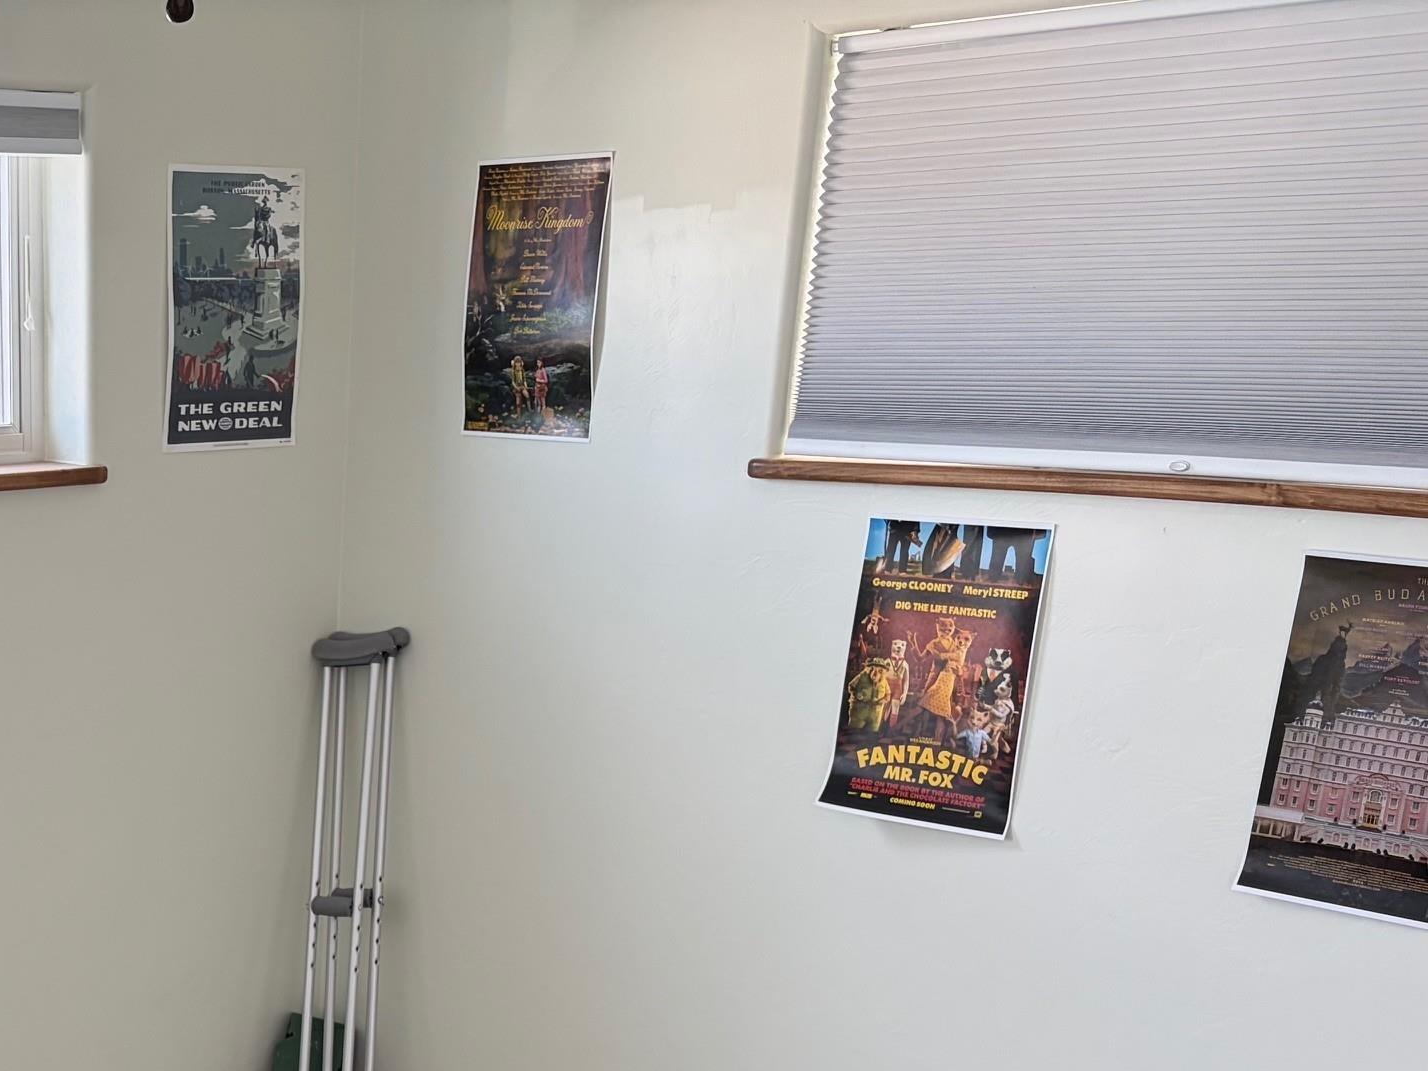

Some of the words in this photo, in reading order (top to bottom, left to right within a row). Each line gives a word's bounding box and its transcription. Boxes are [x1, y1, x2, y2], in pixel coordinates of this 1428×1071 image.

[486, 205, 534, 231] Moonrise
[534, 206, 594, 235] Kingdom
[178, 403, 214, 416] THE
[220, 400, 283, 414] GREEN
[178, 419, 218, 432] NEW
[234, 416, 283, 430] DEAL
[872, 577, 907, 590] George
[908, 581, 954, 594] CLOONEY
[963, 585, 992, 598] Meryl
[992, 588, 1029, 600] STREEP
[895, 601, 911, 610] DIG
[913, 602, 929, 612] THE
[930, 604, 947, 614] LIFE
[948, 606, 997, 619] FANTASTIC
[1309, 594, 1361, 621] GRAND
[1374, 588, 1426, 601] BUDA
[856, 744, 989, 786] FANTASTIC
[883, 765, 916, 783] MR.
[918, 770, 956, 789] FOX
[889, 797, 916, 807] COMING
[916, 801, 936, 810] SOON
